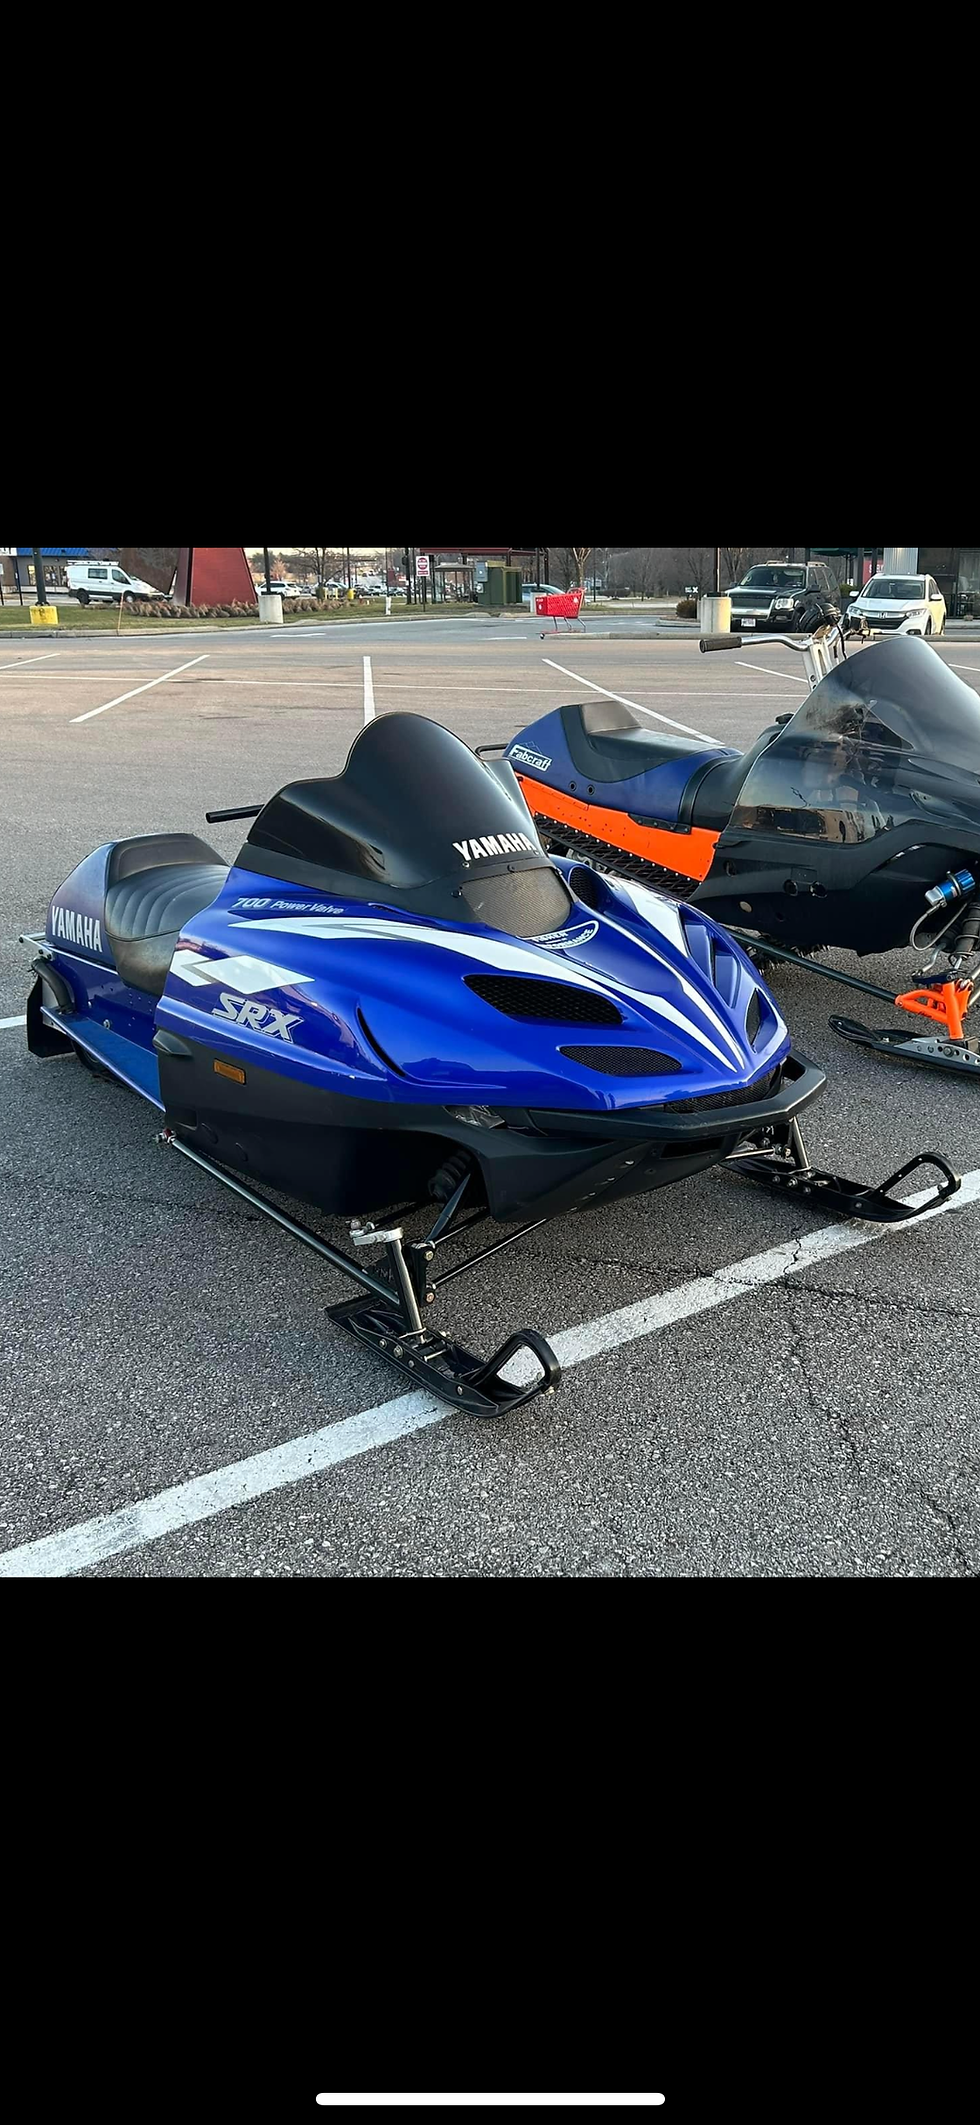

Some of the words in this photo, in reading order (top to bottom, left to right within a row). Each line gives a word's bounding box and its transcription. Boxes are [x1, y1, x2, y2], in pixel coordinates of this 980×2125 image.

[452, 833, 537, 861] YAMAHA
[231, 897, 271, 908] 700
[52, 905, 103, 953] YAMAHA
[212, 992, 304, 1044] SRX
